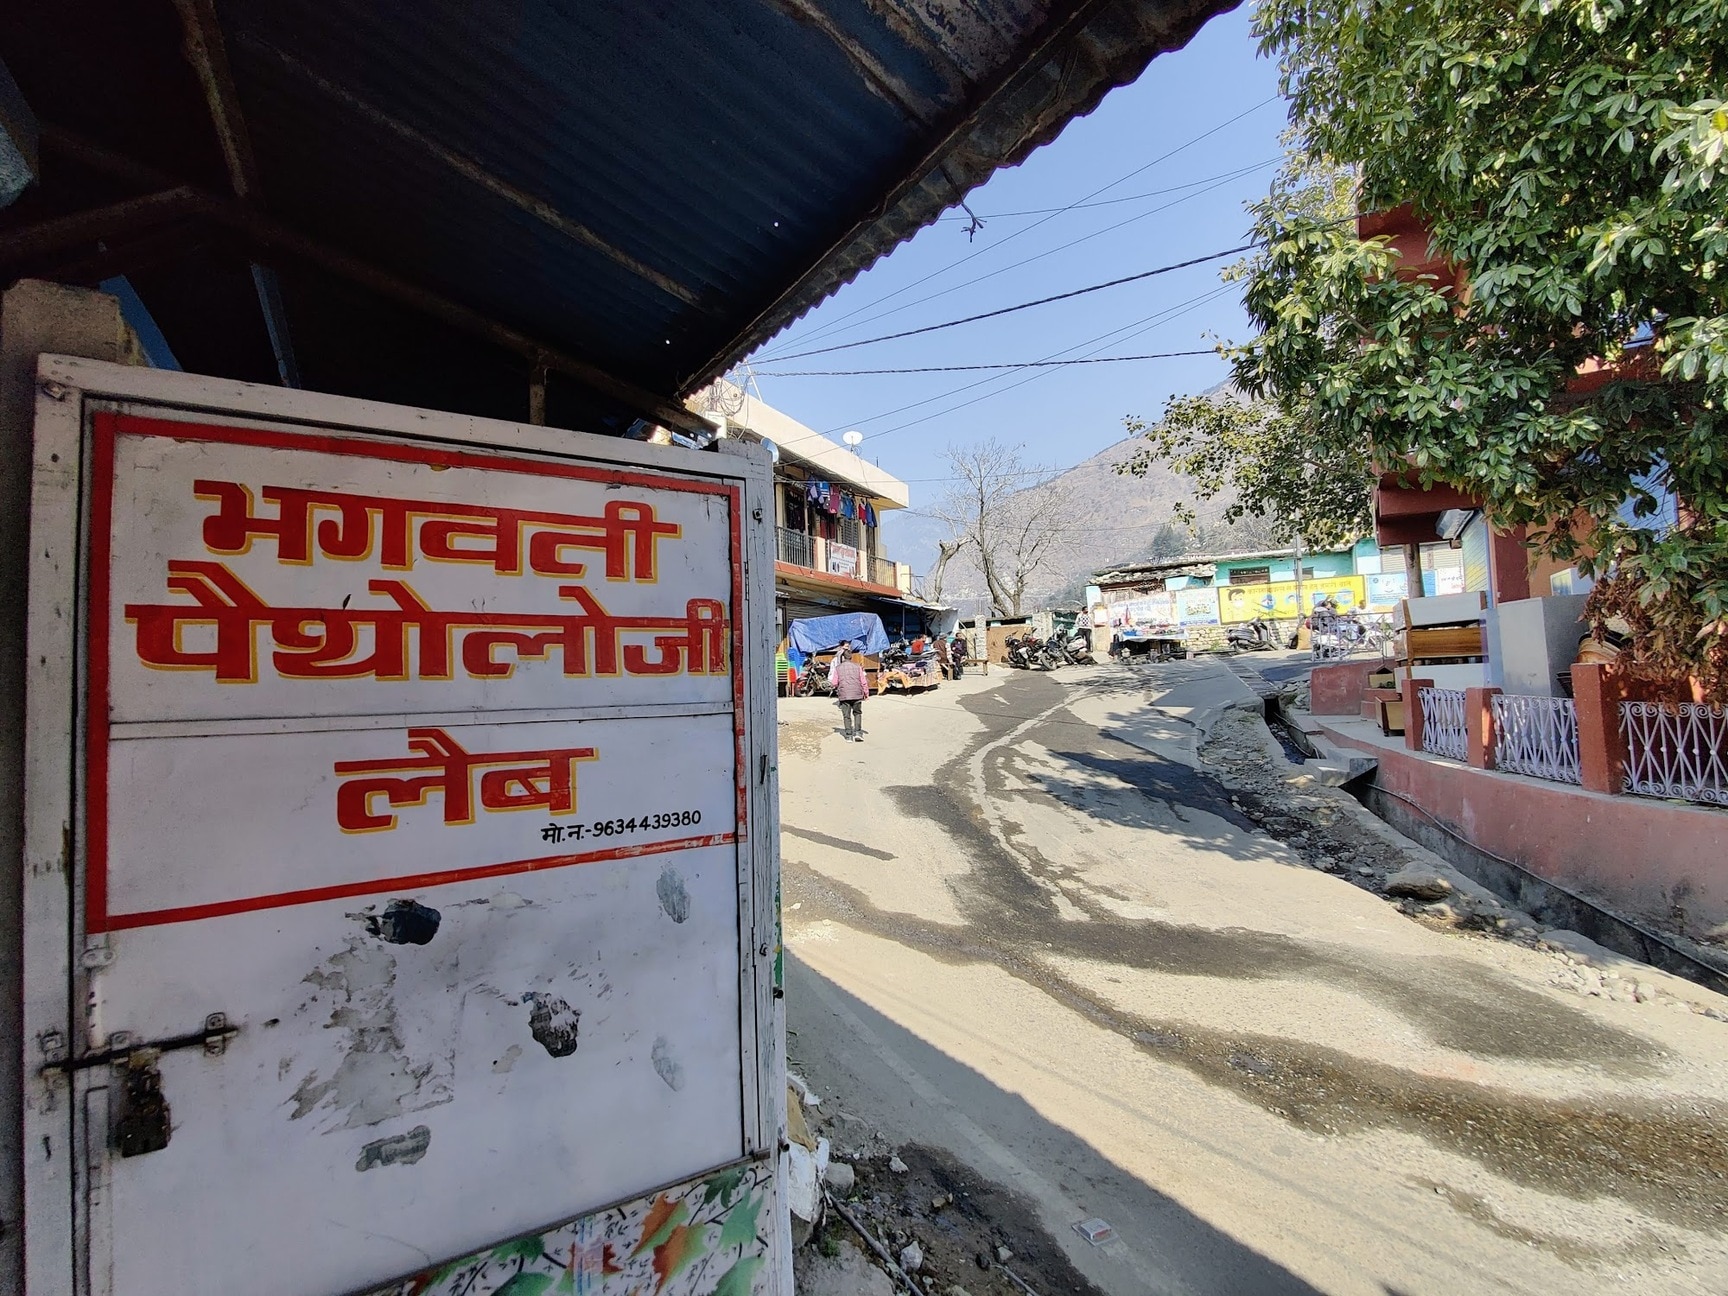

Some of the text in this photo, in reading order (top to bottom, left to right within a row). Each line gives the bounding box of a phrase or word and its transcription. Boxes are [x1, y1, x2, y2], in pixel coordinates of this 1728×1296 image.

[194, 479, 681, 582] भगवती
[125, 560, 730, 683] पैथोलोजी
[334, 728, 598, 834] लैब
